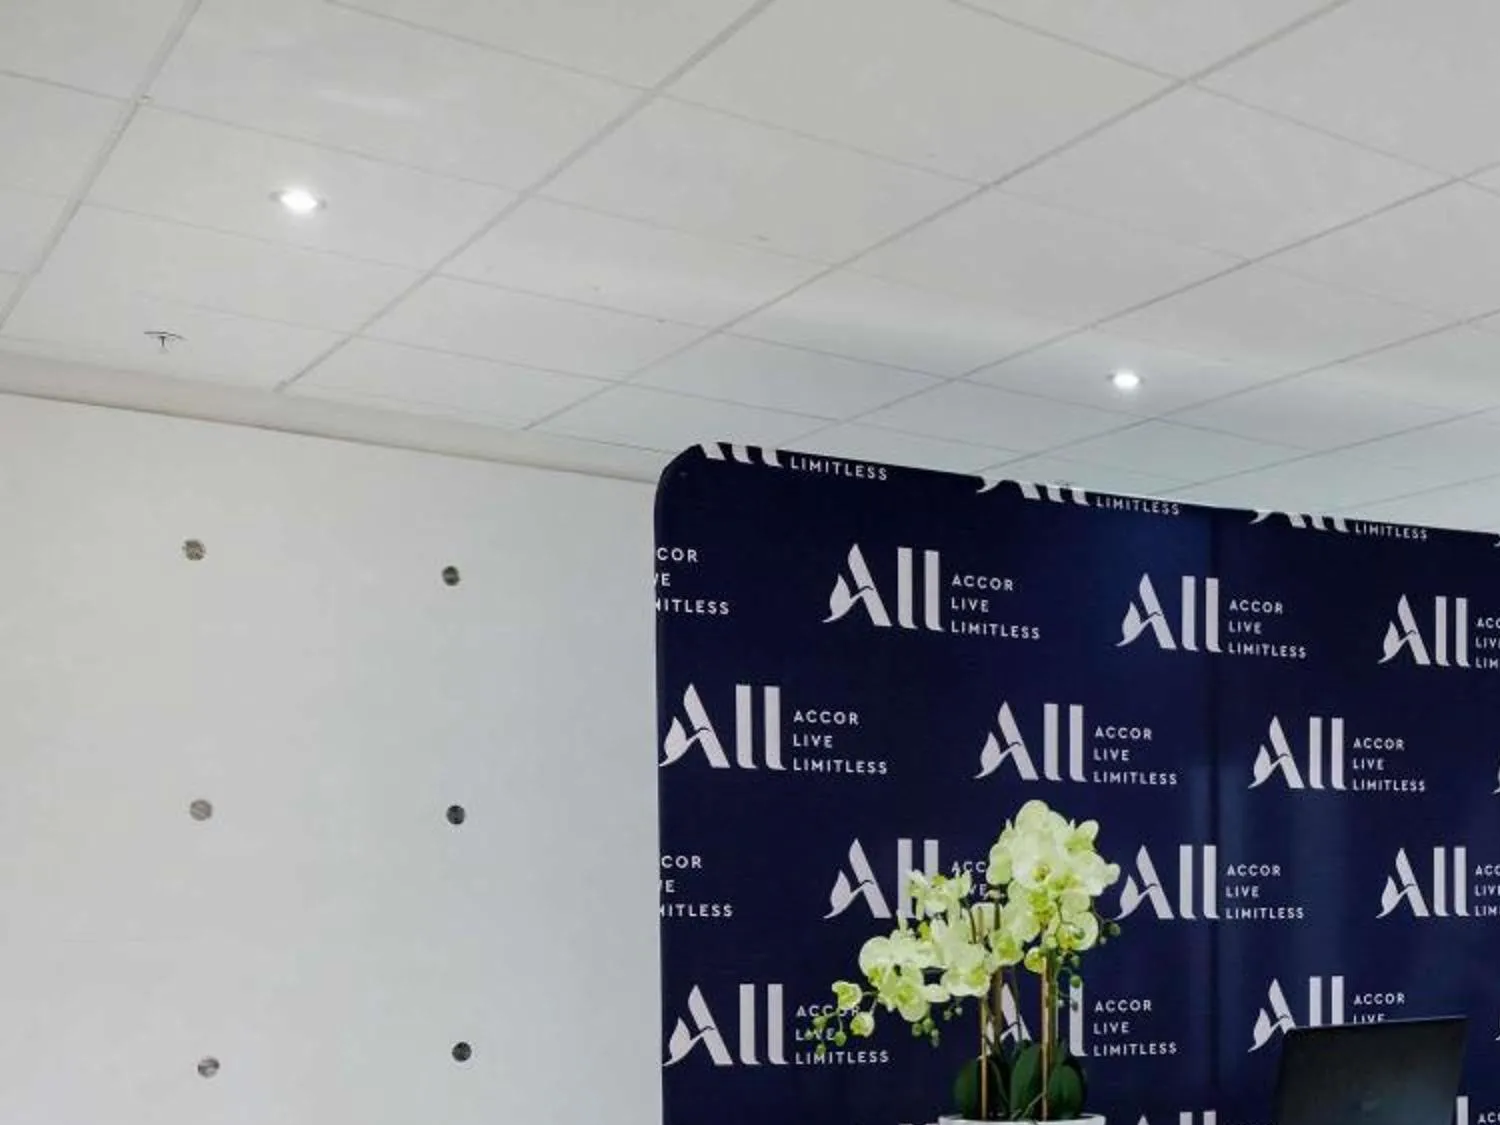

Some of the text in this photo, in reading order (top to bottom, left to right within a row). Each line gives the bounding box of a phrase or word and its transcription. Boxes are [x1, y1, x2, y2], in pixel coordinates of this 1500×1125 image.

[790, 456, 888, 481] LIMITLESS
[1095, 495, 1178, 516] LIMITLESS
[1354, 522, 1428, 541] LIMITLESS
[952, 575, 1014, 591] ACCOR
[951, 597, 990, 613] LIVE
[1229, 599, 1284, 614] ACCOR
[951, 621, 1040, 640] LIMITLESS
[1228, 621, 1262, 634] LIVE
[1228, 643, 1307, 659] LIMITLESS
[793, 709, 859, 725] ACCOR
[793, 734, 834, 748] LIVE
[1094, 726, 1152, 741] ACCOR
[1353, 737, 1404, 751] ACCOR
[1093, 748, 1130, 762] LIVE
[793, 758, 888, 775] LIMITLESS
[1353, 758, 1385, 771] LIVE
[1093, 770, 1178, 785] LIMITLESS
[1353, 779, 1426, 793] LIMITLESS
[951, 860, 987, 874] ACC
[1226, 864, 1282, 877] ACCOR
[1225, 885, 1260, 899] LIVE
[1225, 906, 1305, 921] LIMITLESS
[1094, 999, 1153, 1013] ACCOR
[1353, 992, 1406, 1006] ACCOR
[1093, 1021, 1130, 1036] LIVE
[1093, 1041, 1178, 1057] LIMITLESS
[795, 1049, 890, 1066] LIMITLESS
